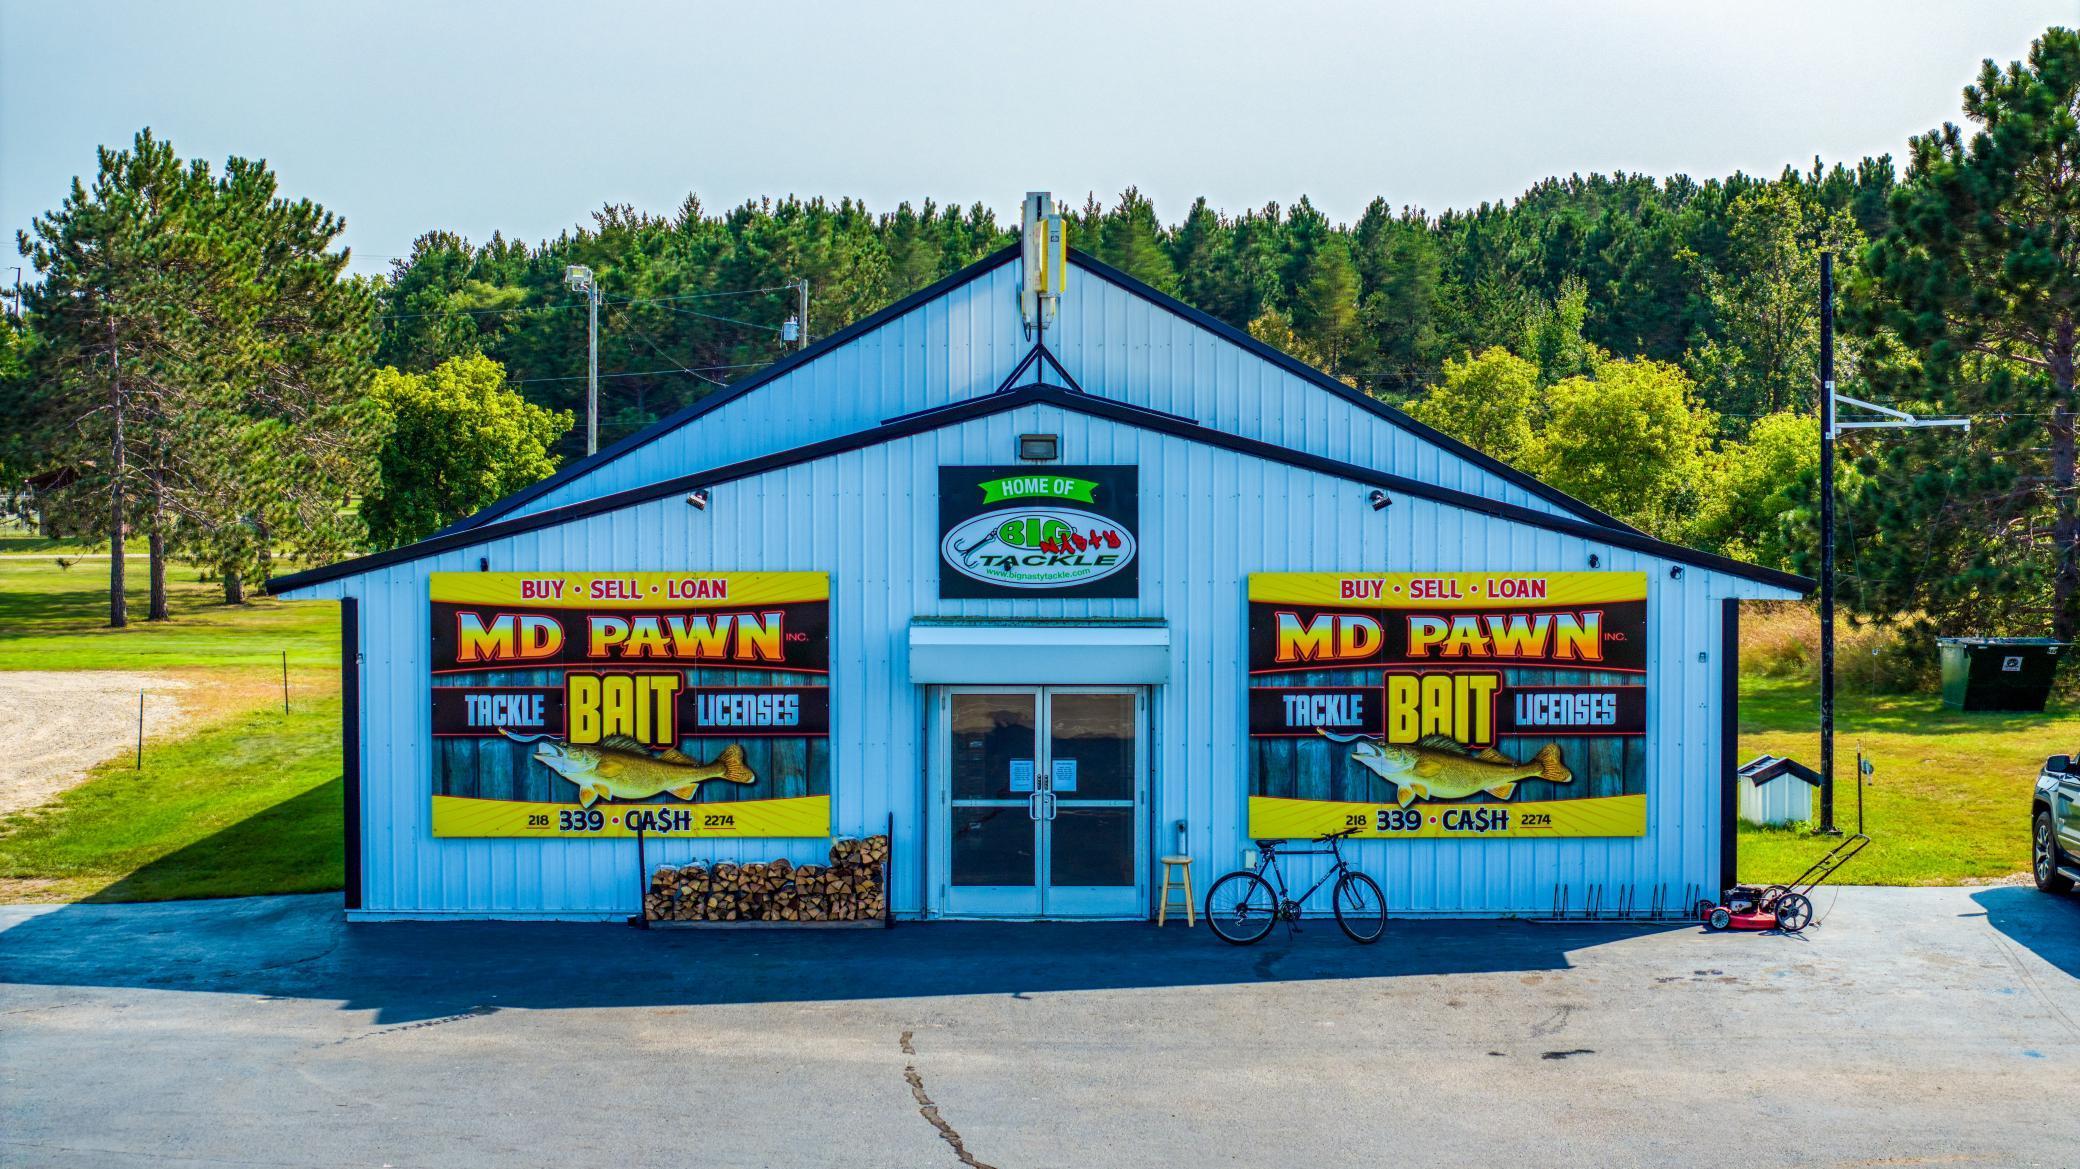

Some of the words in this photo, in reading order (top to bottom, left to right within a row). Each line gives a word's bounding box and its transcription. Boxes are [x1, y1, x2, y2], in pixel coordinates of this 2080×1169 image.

[1002, 478, 1049, 496] HOME
[1053, 479, 1075, 495] OF
[999, 518, 1072, 548] BIG
[980, 554, 1119, 567] TACKLE
[986, 567, 1091, 580] www.bignastytackle.com
[521, 579, 565, 599] BUY
[590, 579, 643, 600] SELL
[668, 579, 728, 599] LOAN
[1340, 578, 1385, 599] BUY
[1410, 579, 1463, 599] SELL
[1487, 578, 1547, 598] LOAN
[457, 611, 564, 662] MD
[587, 611, 785, 662] PAWN
[786, 633, 809, 641] INC.
[1275, 611, 1383, 662] MD
[1406, 611, 1603, 661] PAWN
[1604, 633, 1627, 641] INC.
[464, 694, 545, 727] TACKLE
[568, 674, 680, 745] BAIT
[697, 693, 799, 727] LICENSES
[1283, 694, 1363, 727] TACKLE
[1388, 674, 1497, 744] BAIT
[1515, 693, 1616, 726] LICENSES
[528, 815, 549, 826] 218
[559, 810, 605, 831] 339
[625, 807, 692, 834] CA$H
[704, 815, 735, 826] 2274
[1345, 815, 1367, 826] 218
[1376, 809, 1422, 831] 339
[1442, 807, 1509, 833] CA$H
[1521, 814, 1551, 825] 2274
